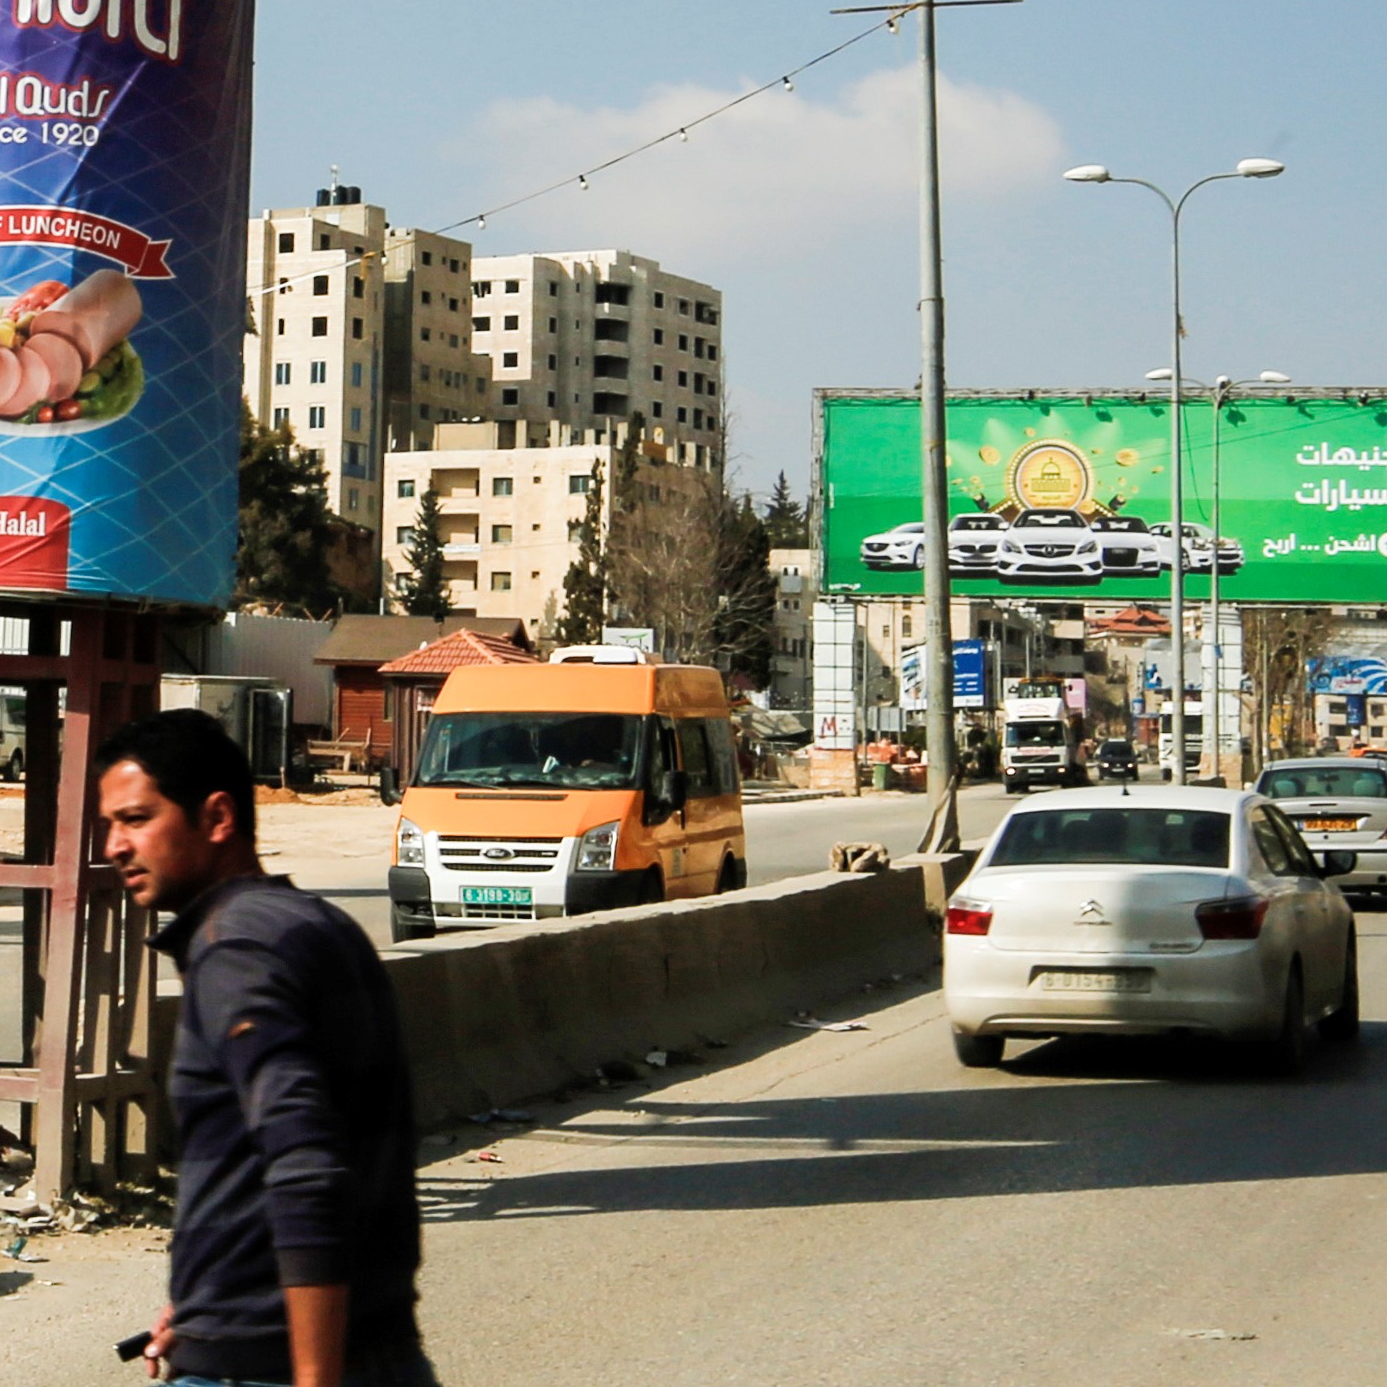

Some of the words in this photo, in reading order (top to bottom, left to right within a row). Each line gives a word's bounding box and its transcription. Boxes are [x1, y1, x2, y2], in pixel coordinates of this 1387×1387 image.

[15, 75, 109, 118] Quds
[42, 122, 99, 147] 1920
[9, 215, 121, 249] LUNCHEON
[1296, 442, 1387, 471] نيهات
